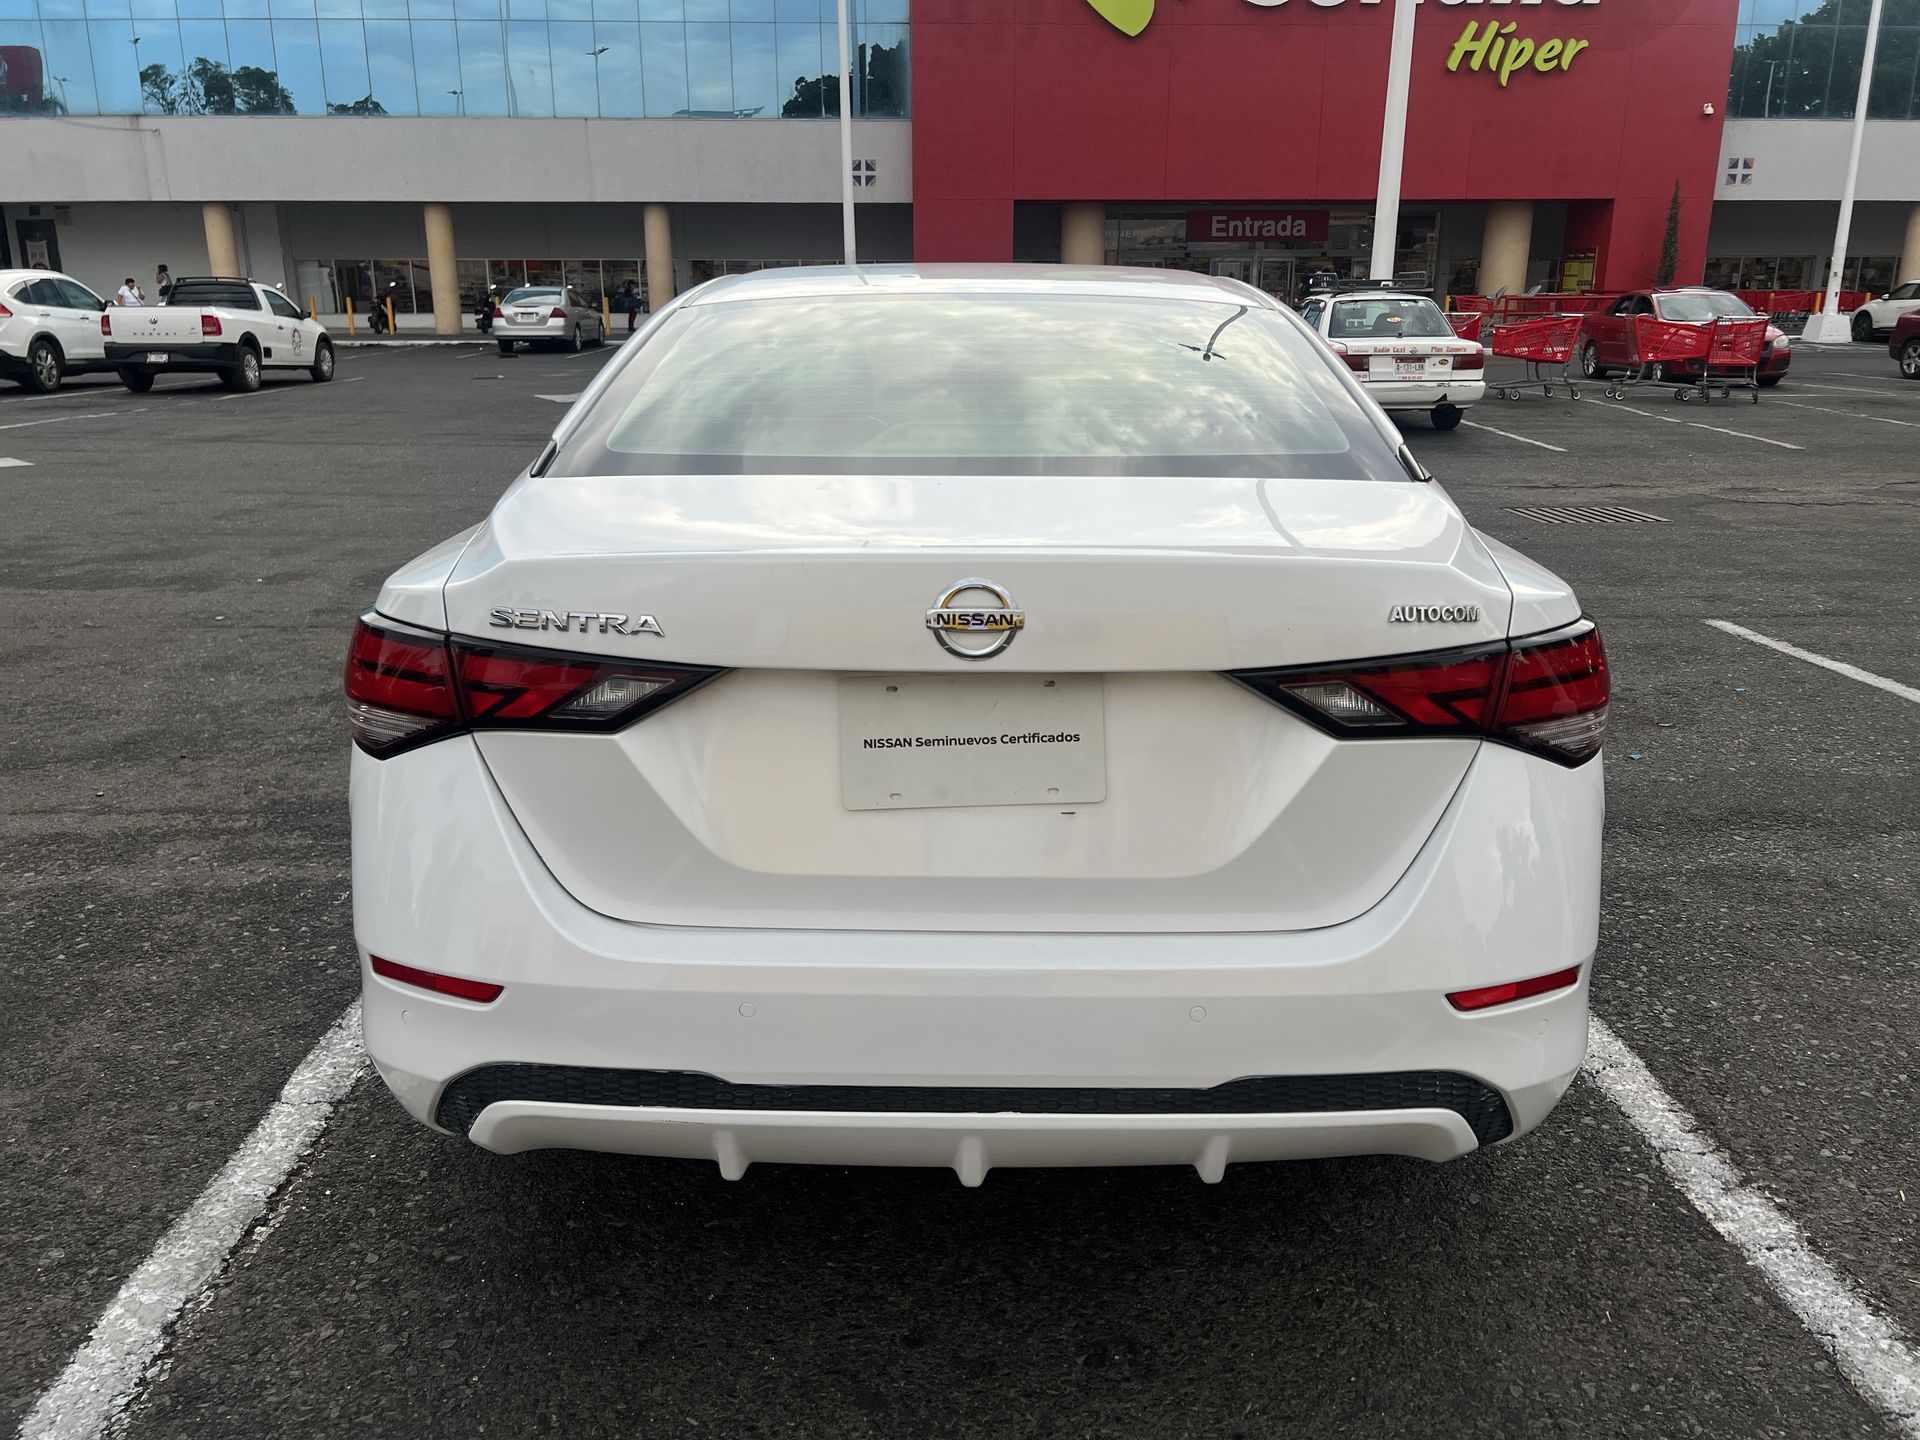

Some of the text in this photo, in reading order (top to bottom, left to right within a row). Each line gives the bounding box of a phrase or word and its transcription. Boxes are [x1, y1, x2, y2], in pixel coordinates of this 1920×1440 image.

[1211, 214, 1307, 237] Entrada
[489, 606, 665, 637] SENTRA
[937, 612, 1014, 626] NISSAN
[1388, 604, 1480, 623] AUTOCOM
[863, 732, 1081, 749] NISSAN Seminuevos Certificados
